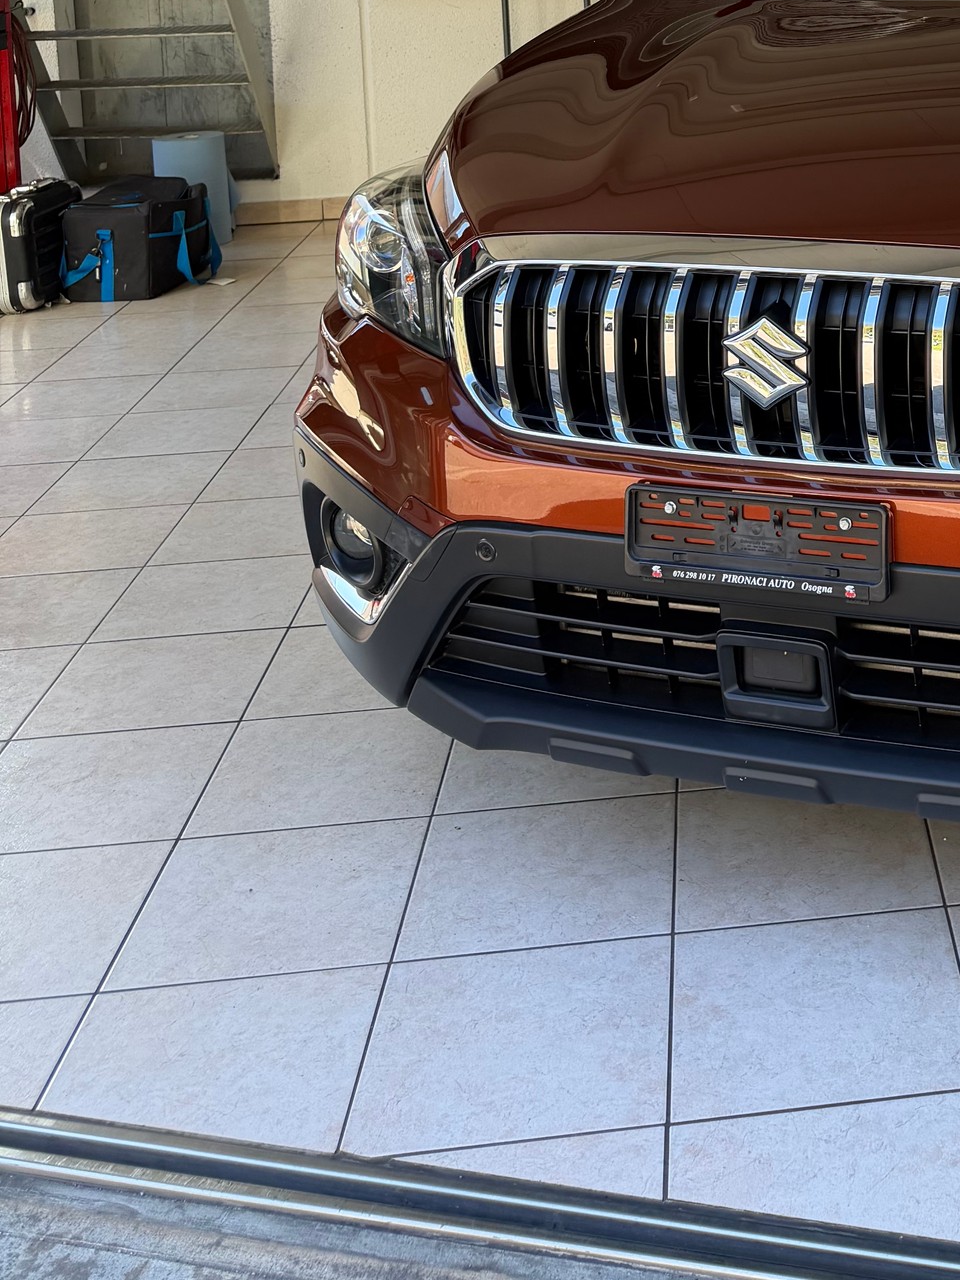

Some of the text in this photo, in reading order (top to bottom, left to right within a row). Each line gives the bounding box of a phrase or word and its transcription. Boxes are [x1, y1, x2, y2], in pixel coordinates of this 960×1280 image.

[672, 570, 833, 594] 076 298 10 17 PIRONACI AUTO Osogna
